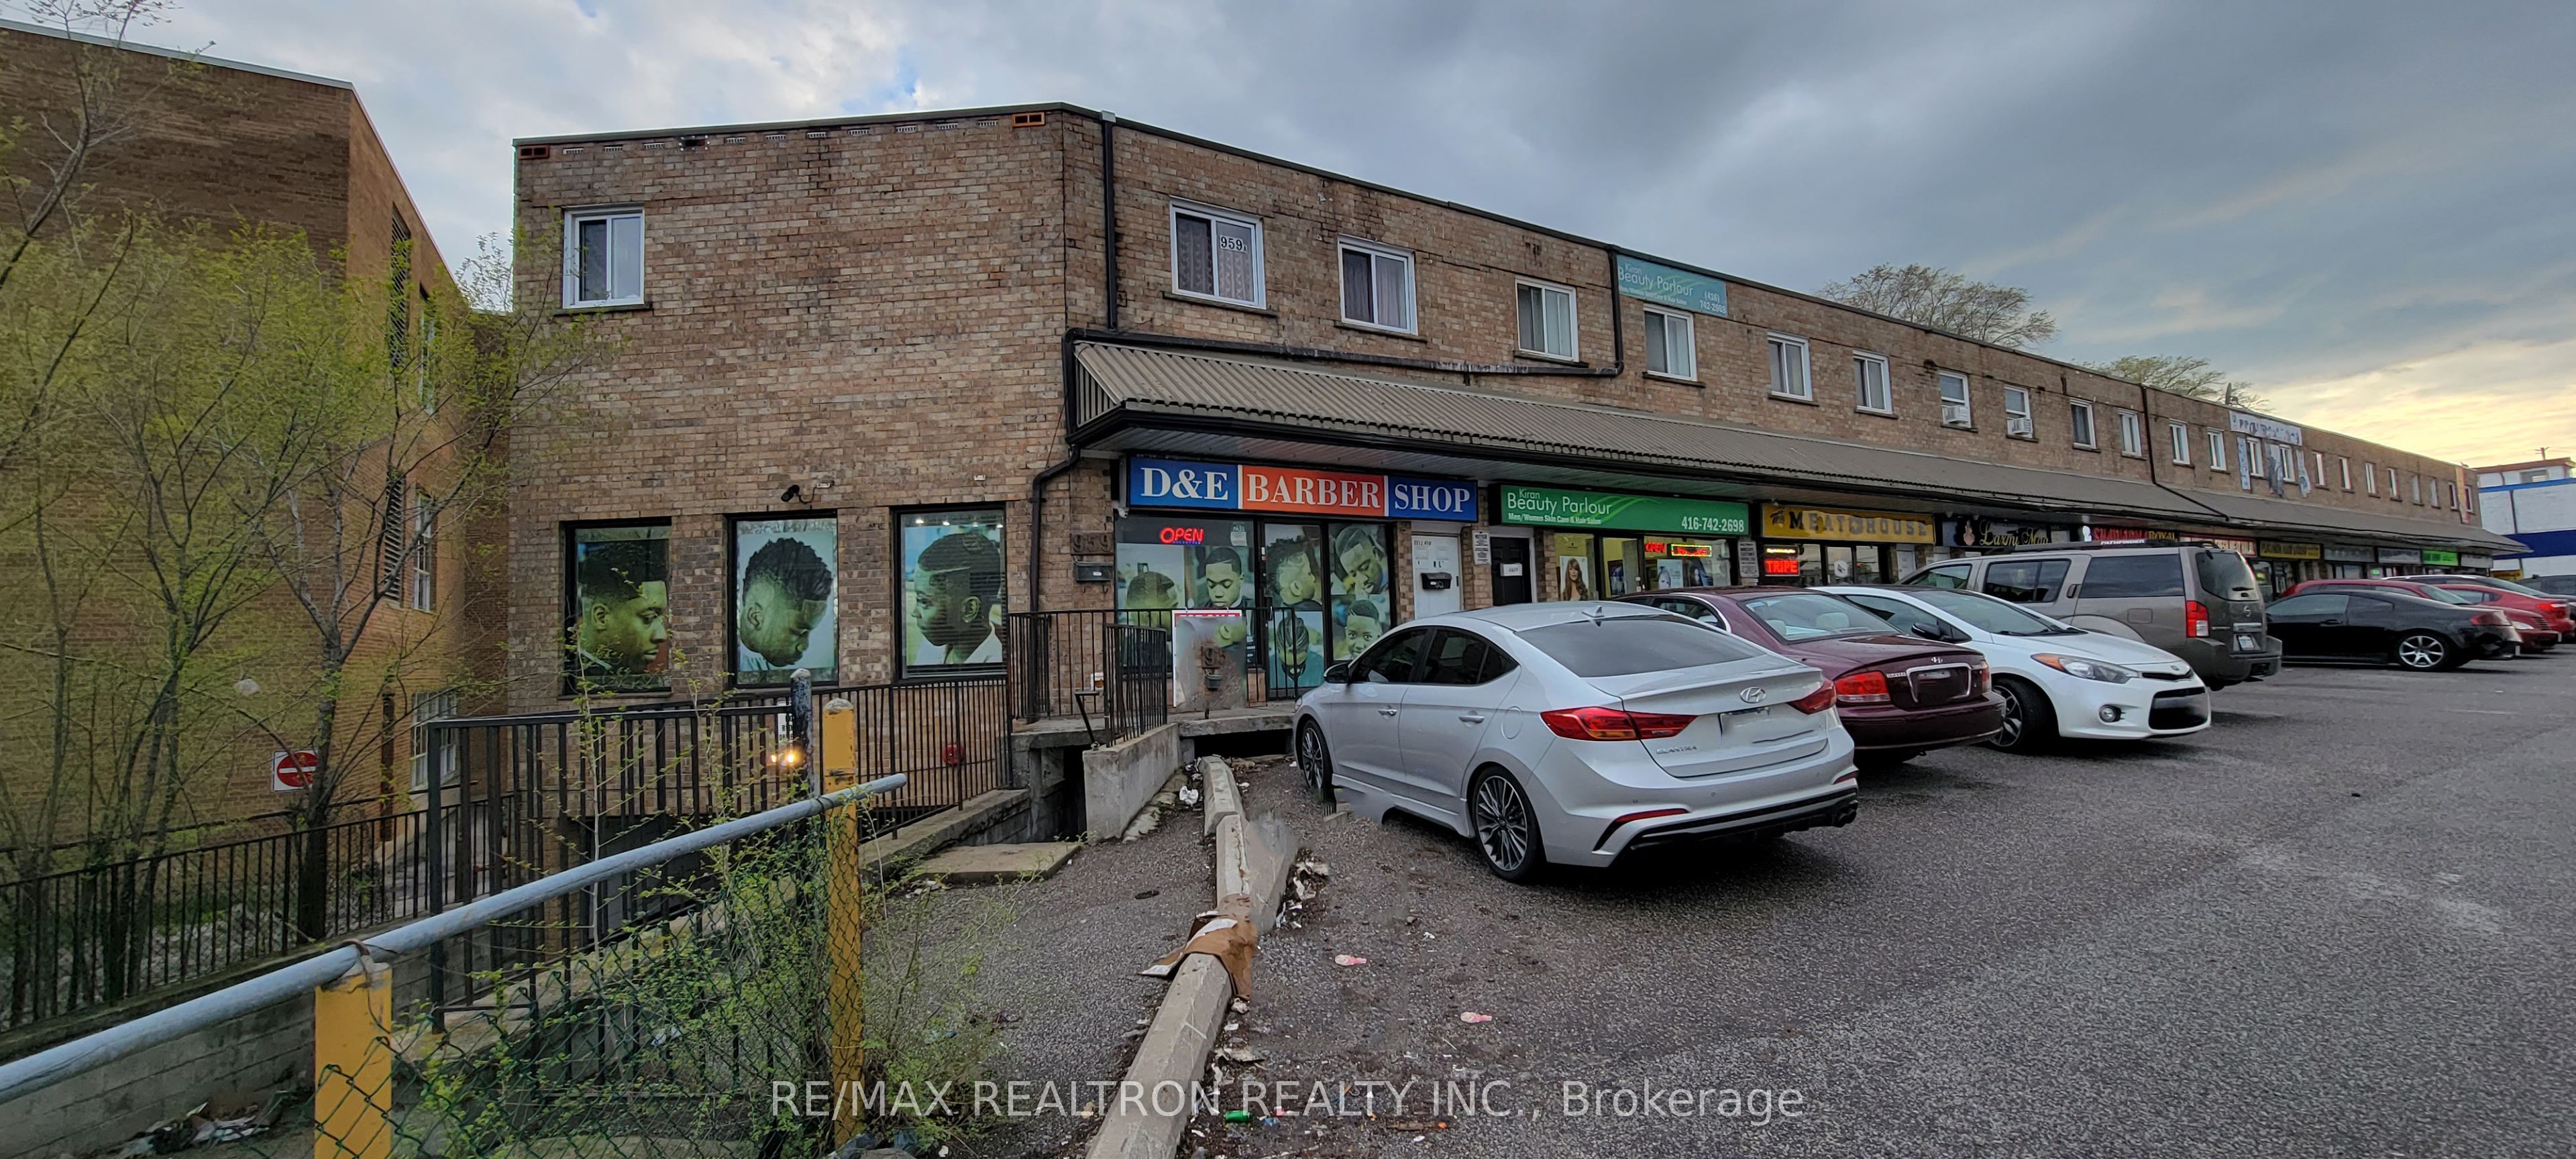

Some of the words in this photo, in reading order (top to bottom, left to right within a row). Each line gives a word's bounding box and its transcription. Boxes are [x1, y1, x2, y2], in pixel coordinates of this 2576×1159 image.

[1618, 266, 1654, 290] Beauty
[1657, 275, 1693, 296] Parlour
[1140, 467, 1229, 501] D&E
[1247, 474, 1381, 508] BARBER
[1395, 484, 1470, 512] SHOP
[1519, 488, 1540, 499] Kiran
[1507, 492, 1557, 515] Beauty
[1562, 496, 1612, 514] Parlour
[1681, 516, 1744, 533] 416-742-2698
[1160, 527, 1204, 545] OPEN
[1765, 559, 1798, 574] TRIPE
